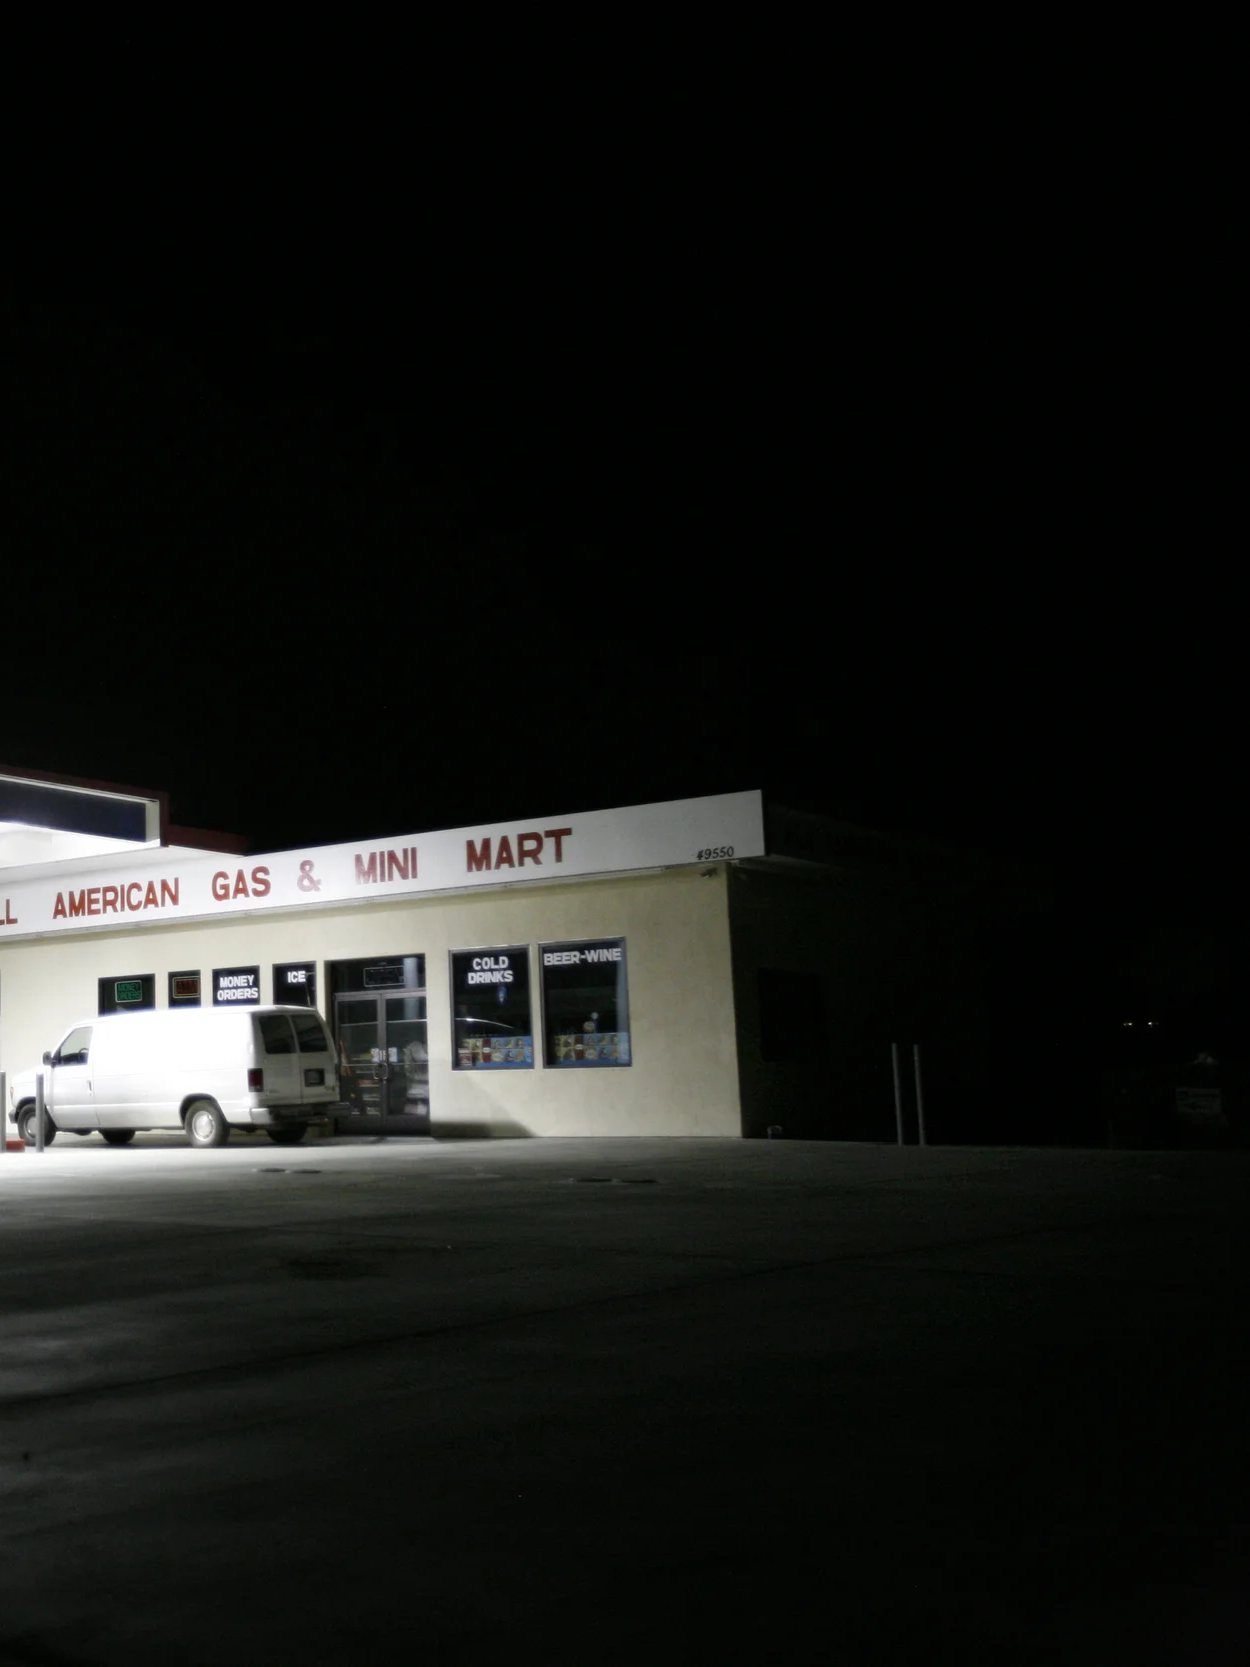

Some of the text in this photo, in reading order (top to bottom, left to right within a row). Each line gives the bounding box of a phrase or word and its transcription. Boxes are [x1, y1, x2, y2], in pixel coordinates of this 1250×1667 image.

[696, 846, 735, 861] 49550
[53, 877, 180, 920] AMERICAN
[211, 866, 271, 902] GAS
[297, 859, 322, 892] &
[355, 847, 418, 885] MINI
[466, 827, 572, 872] MART
[472, 956, 509, 971] COLD
[543, 947, 622, 966] BEER-WINE
[219, 974, 254, 989] MONEY
[287, 970, 306, 984] ICE
[467, 970, 514, 984] DRINKS
[216, 987, 258, 1001] ORDERS
